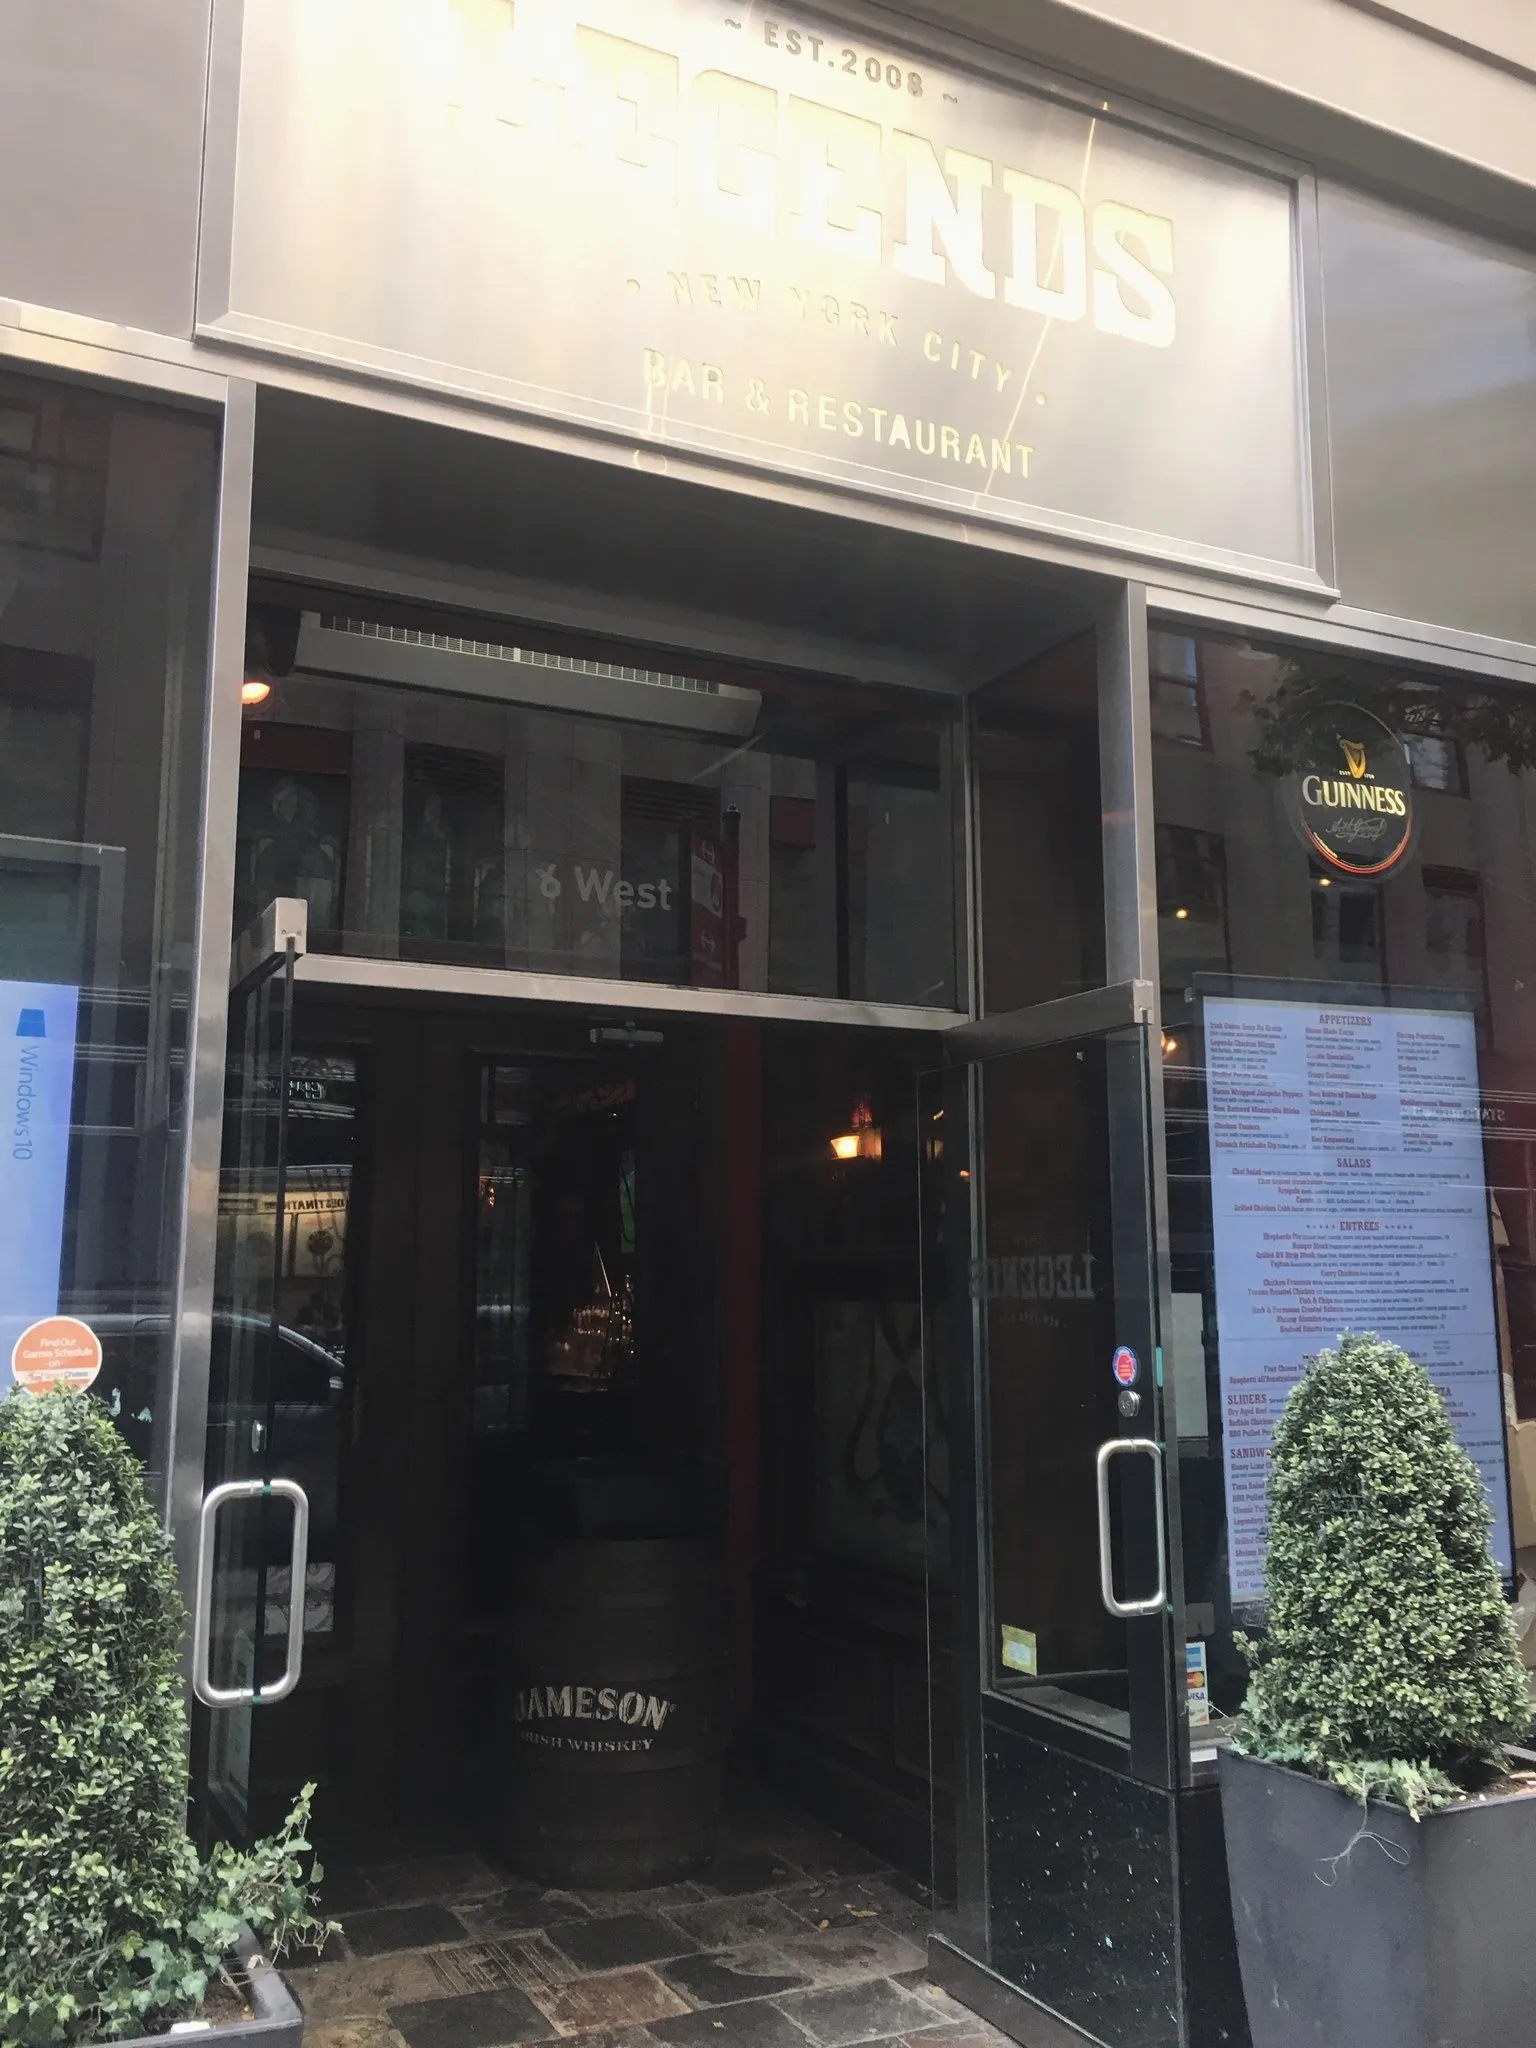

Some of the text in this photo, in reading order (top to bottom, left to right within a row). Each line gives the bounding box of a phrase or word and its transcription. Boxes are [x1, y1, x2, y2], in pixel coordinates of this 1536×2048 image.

[666, 269, 1012, 393] NEW YORK CITY
[643, 347, 1035, 479] BAR & RESTAURANT
[1302, 775, 1406, 817] GUINNESS
[574, 866, 671, 911] West
[1319, 1014, 1372, 1026] APPETIZERS
[1337, 1158, 1371, 1168] SALADS
[40, 1337, 77, 1347] Find Our
[54, 1346, 93, 1357] Schedule
[1227, 1394, 1267, 1405] SLIDERS
[1230, 1447, 1266, 1459] SANDW
[515, 1685, 668, 1731] JAMESON
[568, 1738, 653, 1752] WHISKEY
